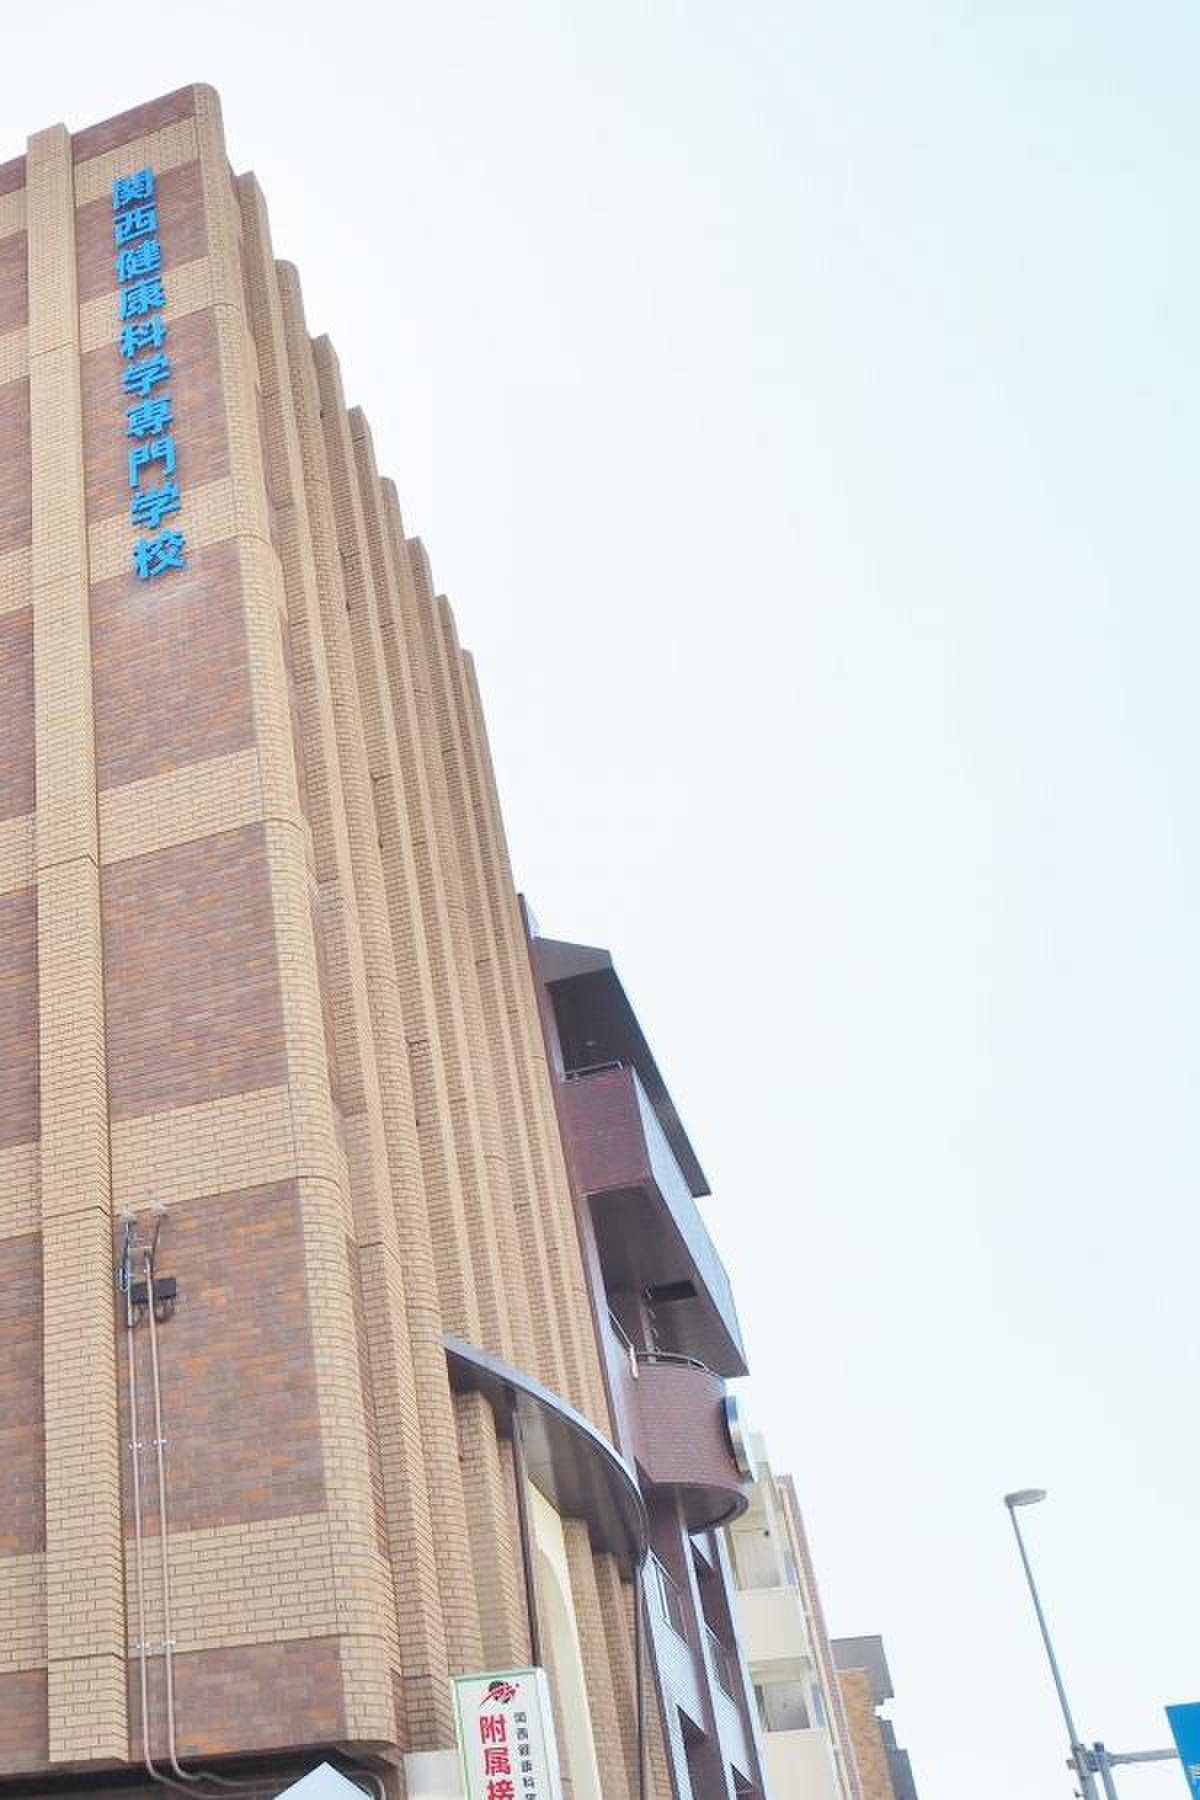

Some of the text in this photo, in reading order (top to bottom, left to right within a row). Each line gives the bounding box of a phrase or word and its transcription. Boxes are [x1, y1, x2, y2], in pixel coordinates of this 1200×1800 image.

[112, 166, 186, 578] 関西健康科学専門学校
